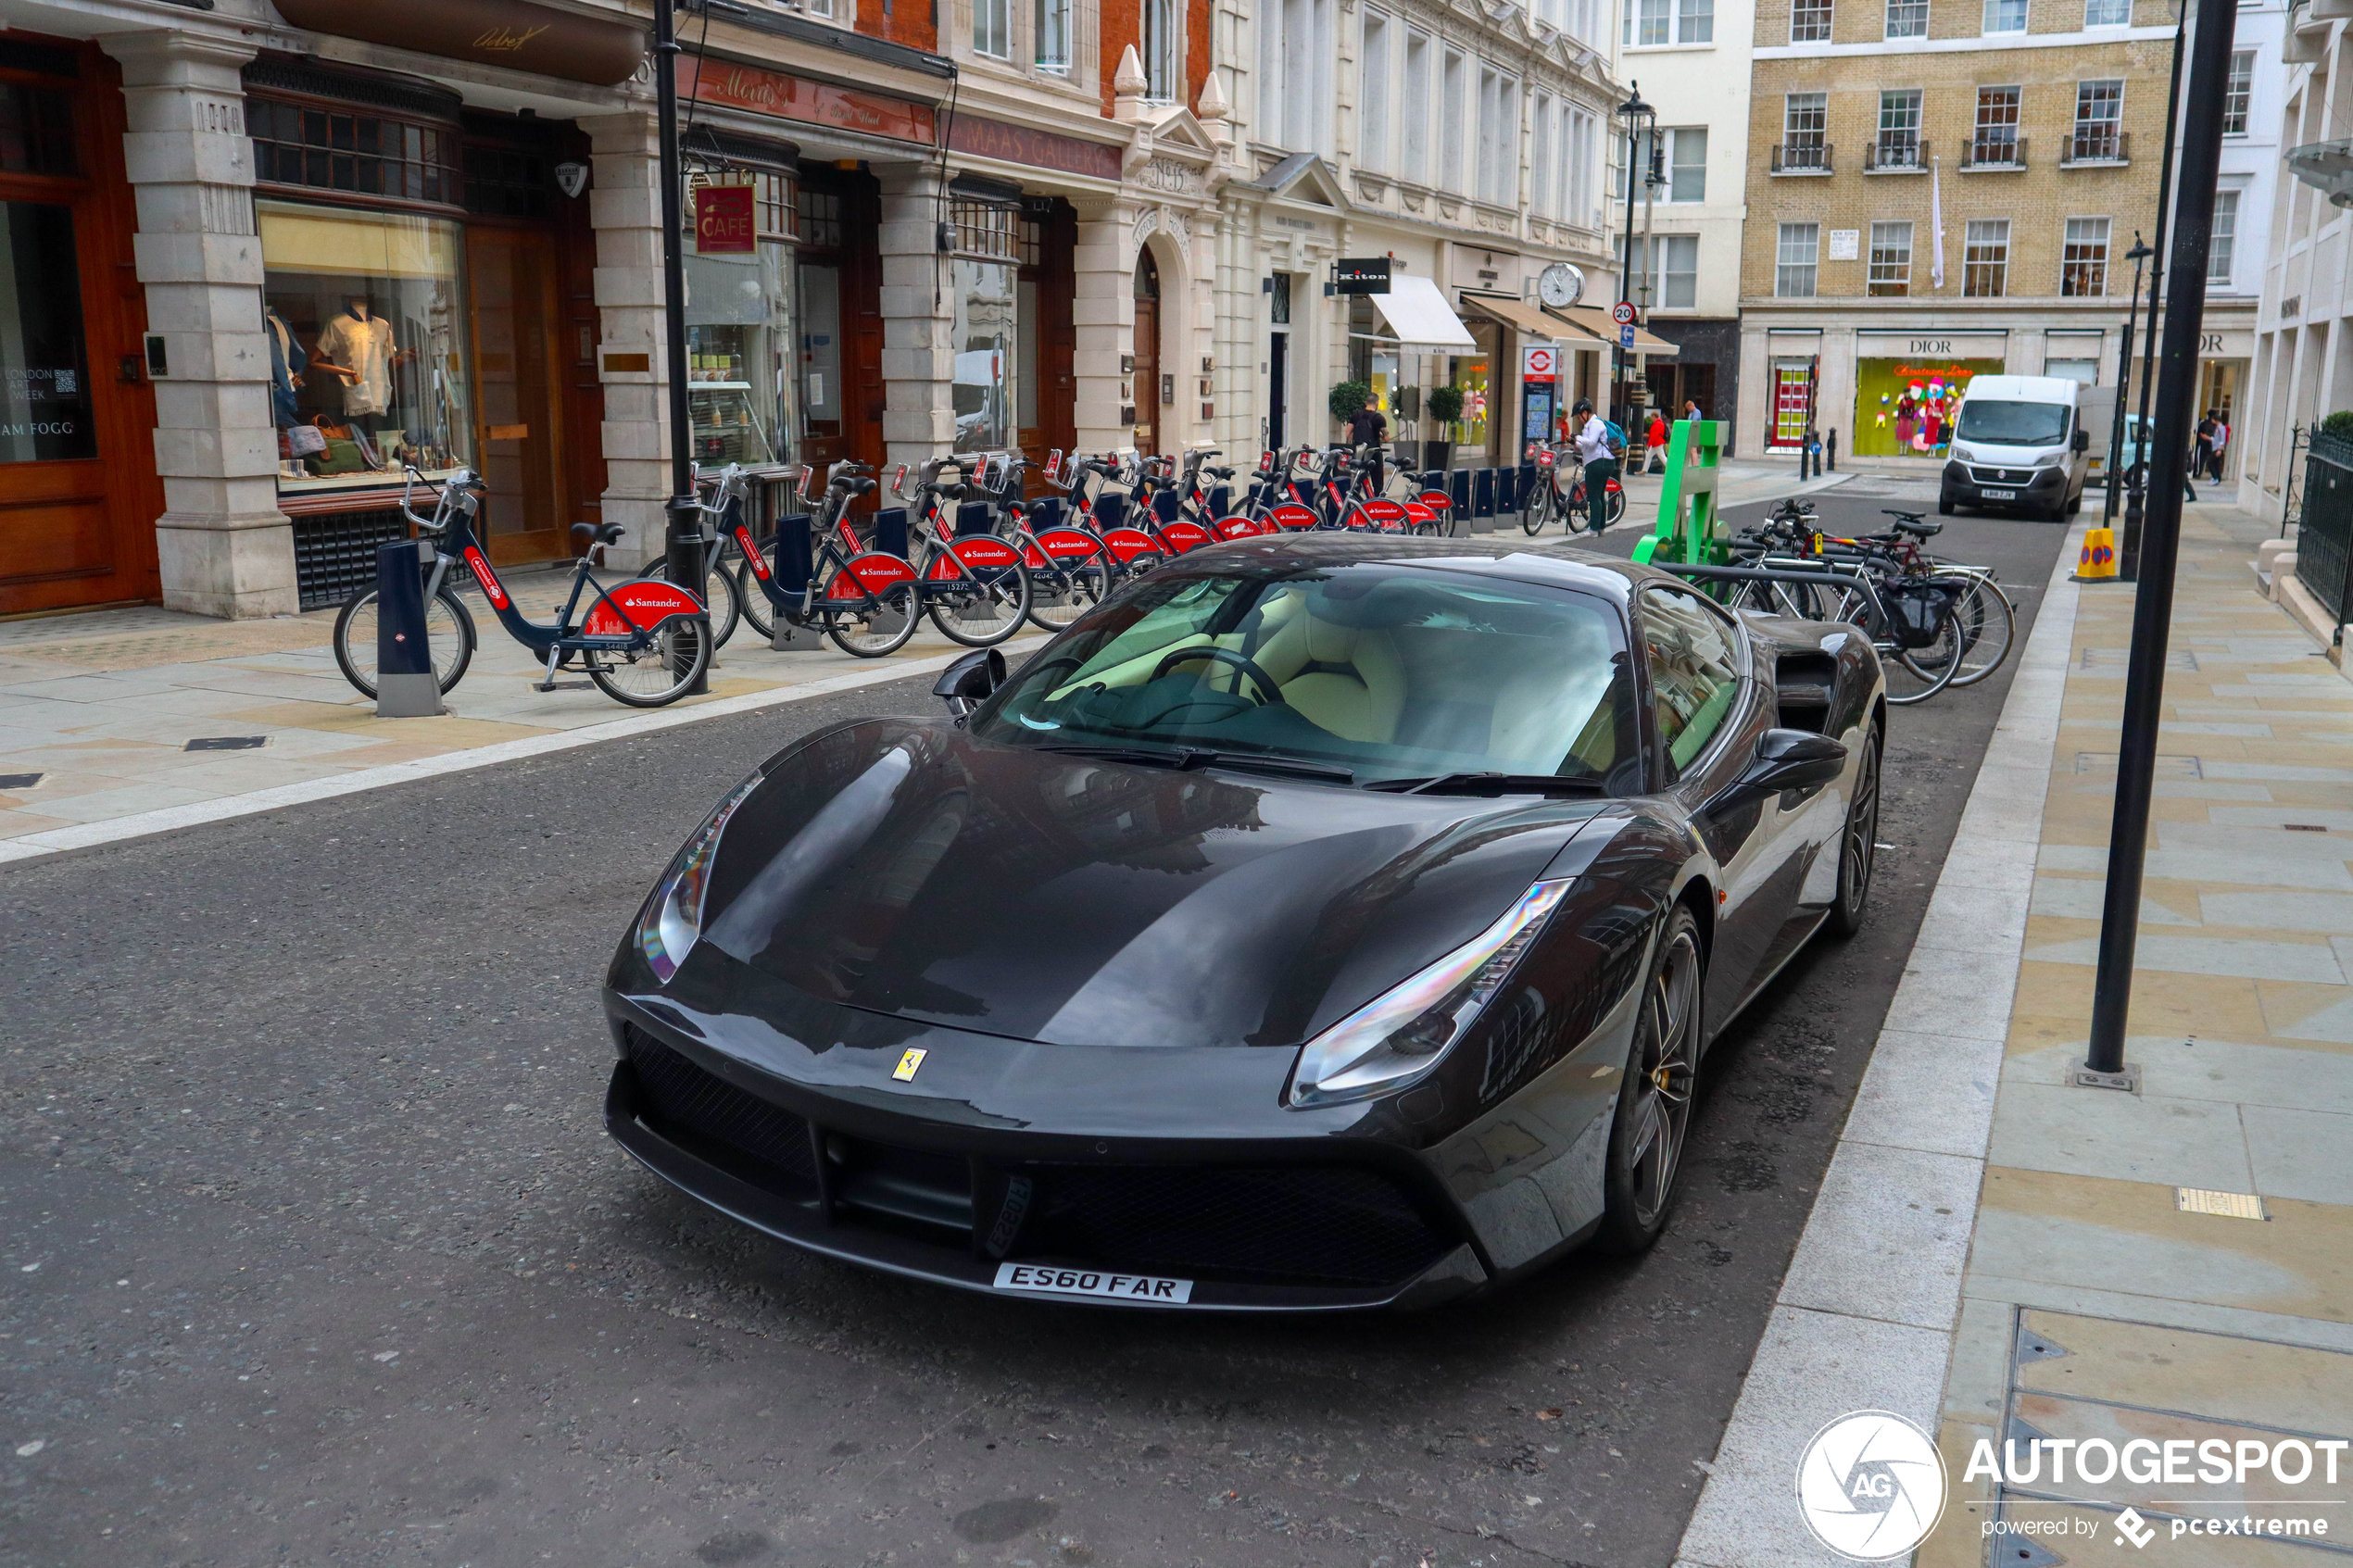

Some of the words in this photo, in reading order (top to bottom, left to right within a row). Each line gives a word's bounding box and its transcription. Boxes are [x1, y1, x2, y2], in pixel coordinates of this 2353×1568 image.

[716, 69, 788, 107] Morris's
[830, 104, 853, 121] Bond
[966, 120, 1023, 158] MAAS
[1032, 134, 1104, 174] GALLERY
[701, 211, 750, 237] CAFÉ
[1339, 270, 1388, 280] Kiton
[1616, 308, 1631, 319] 20
[1910, 340, 1951, 353] DIOR
[6, 370, 53, 380] LONDON
[9, 379, 30, 389] ART
[13, 390, 45, 400] WEEK
[30, 421, 72, 434] FOGG
[1056, 540, 1089, 548] Santander
[476, 564, 493, 585] Santander
[868, 568, 903, 576] Santander
[635, 597, 681, 608] Santander
[605, 642, 628, 650] 54418
[1010, 1266, 1101, 1290] ES60
[1108, 1276, 1176, 1298] FAR
